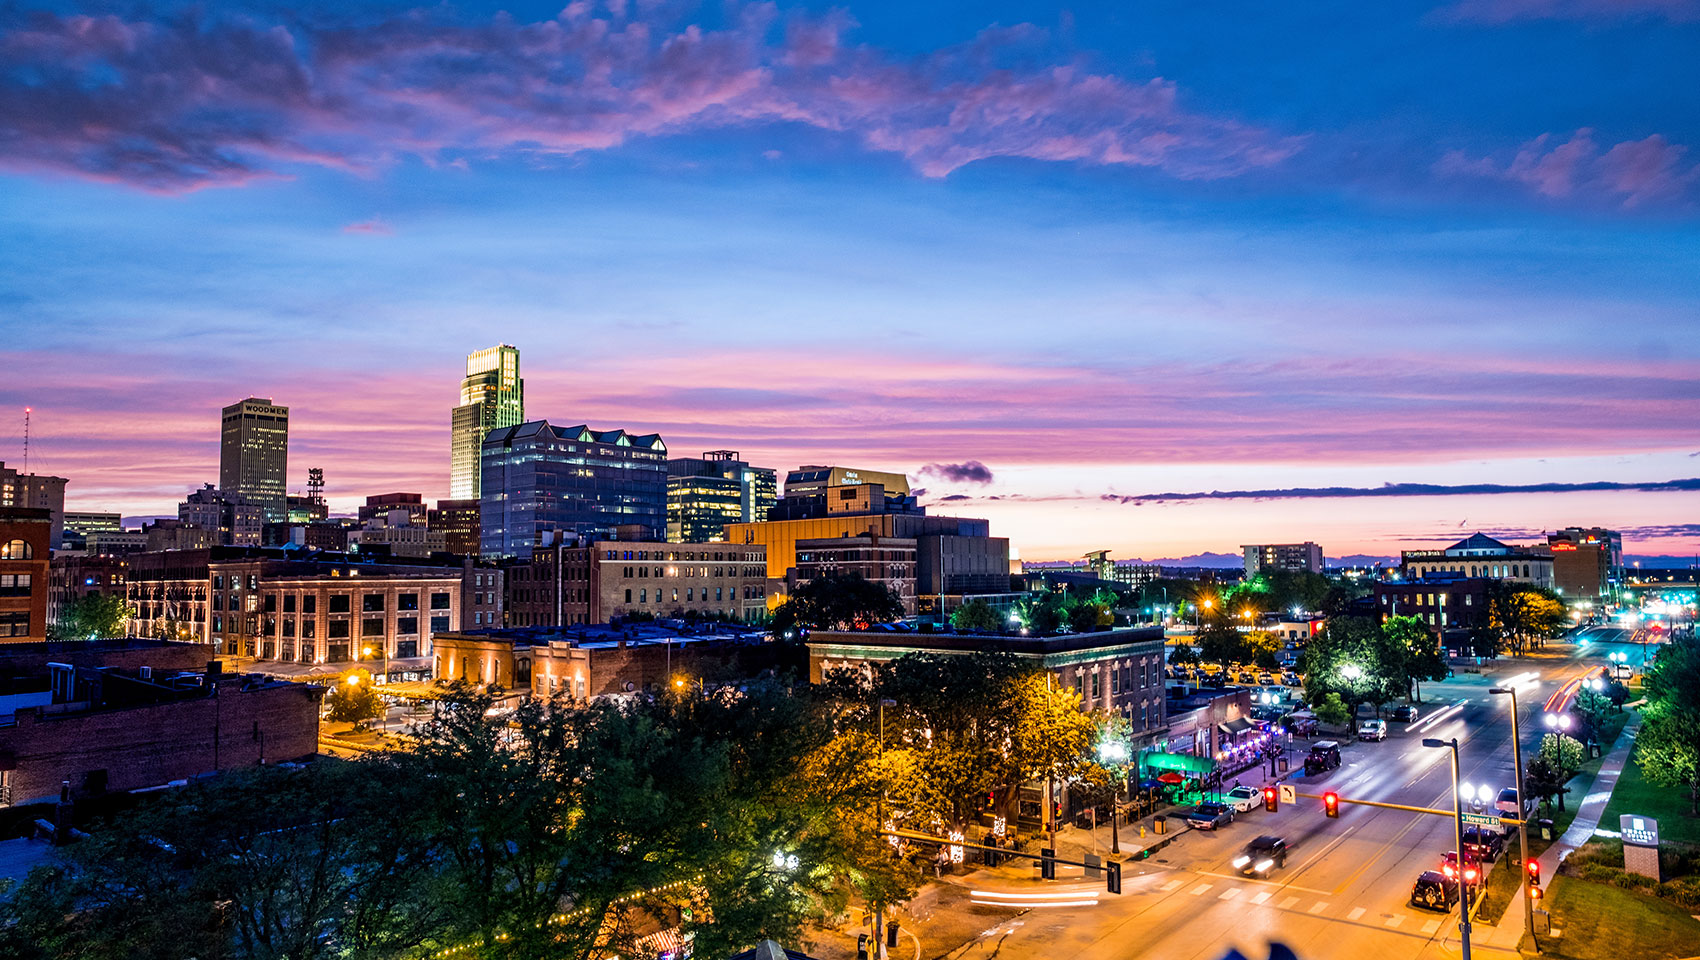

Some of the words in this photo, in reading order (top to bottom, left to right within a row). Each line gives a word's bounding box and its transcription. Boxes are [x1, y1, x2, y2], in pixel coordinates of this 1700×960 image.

[245, 405, 287, 415] WOODMEN
[1466, 815, 1490, 824] Howard
[1490, 817, 1498, 825] St
